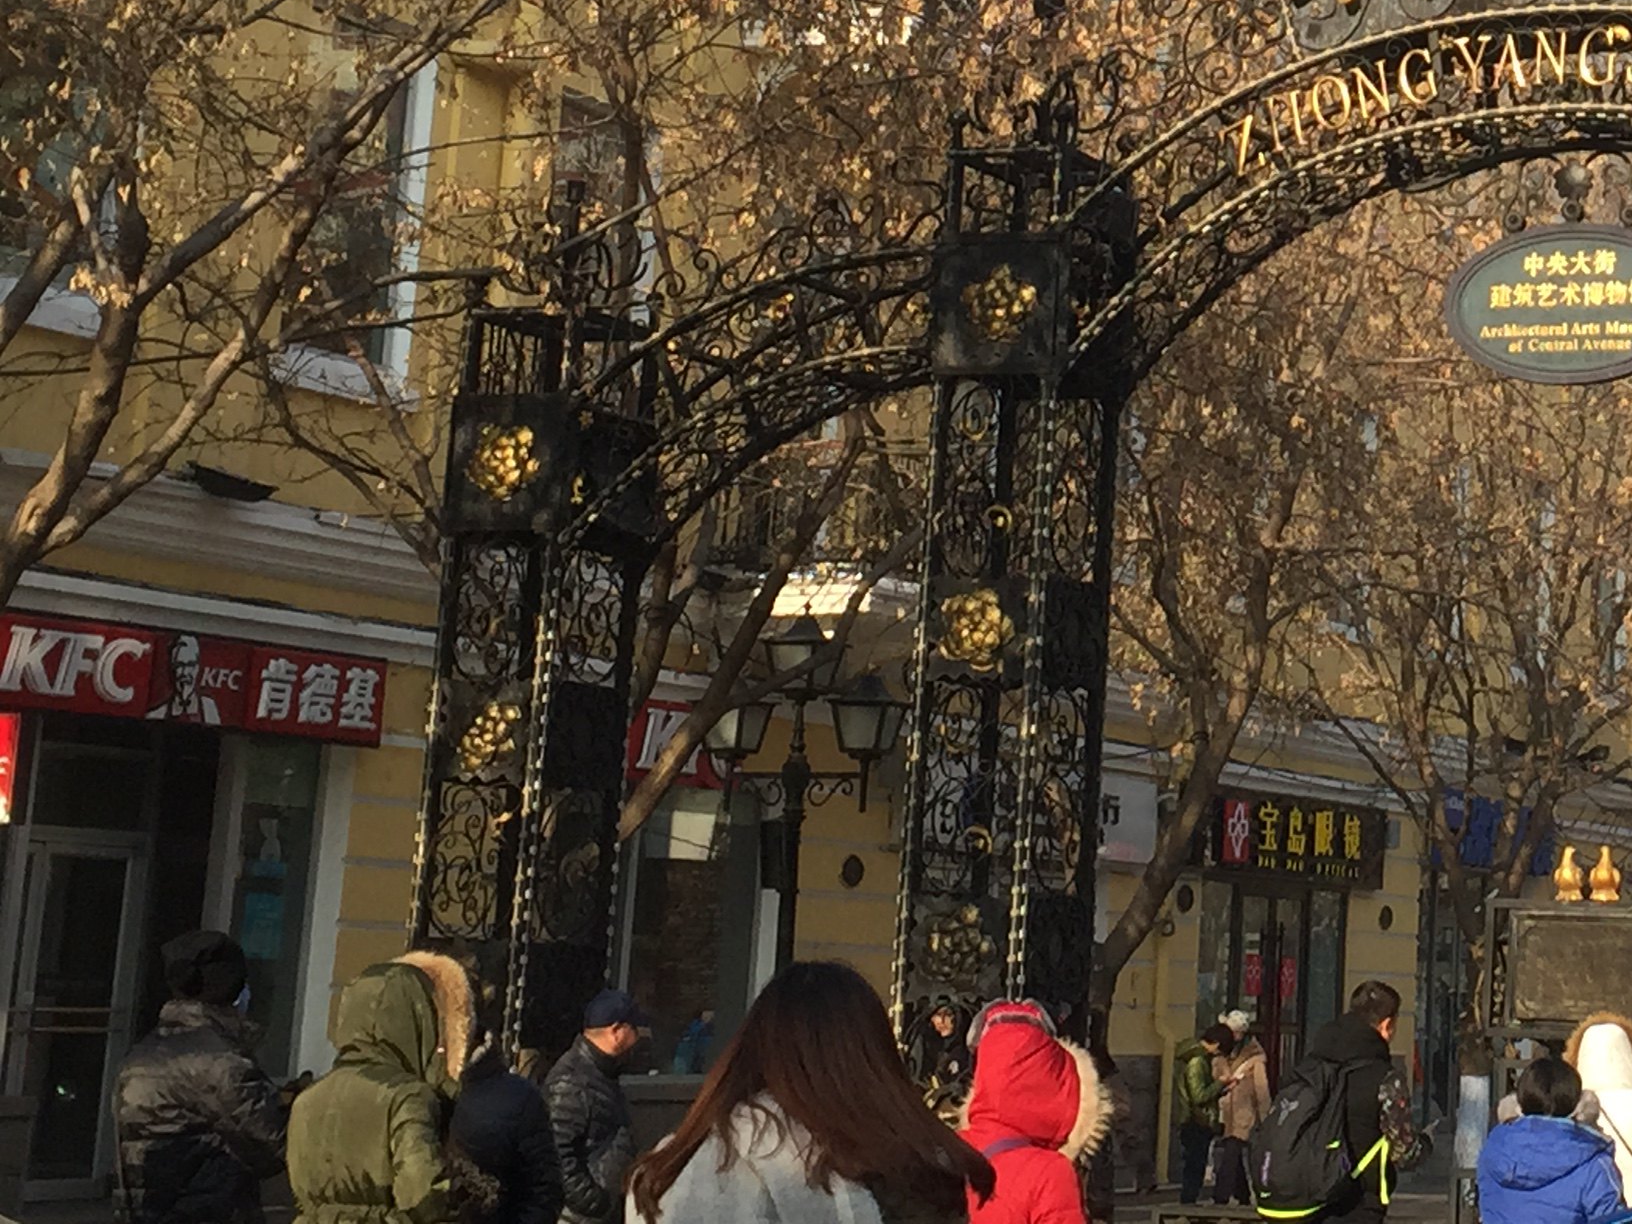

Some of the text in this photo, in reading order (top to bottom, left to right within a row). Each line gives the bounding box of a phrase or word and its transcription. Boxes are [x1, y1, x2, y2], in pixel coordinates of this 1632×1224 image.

[1523, 249, 1618, 278] 中央大街
[1480, 322, 1568, 338] Architectural
[1571, 322, 1600, 336] Arts
[1508, 338, 1632, 353] of Central Avenue
[0, 625, 151, 703] KFC
[201, 665, 243, 691] KFC
[255, 657, 381, 729] 肯德基
[1257, 800, 1362, 860] 宝岛眼镜
